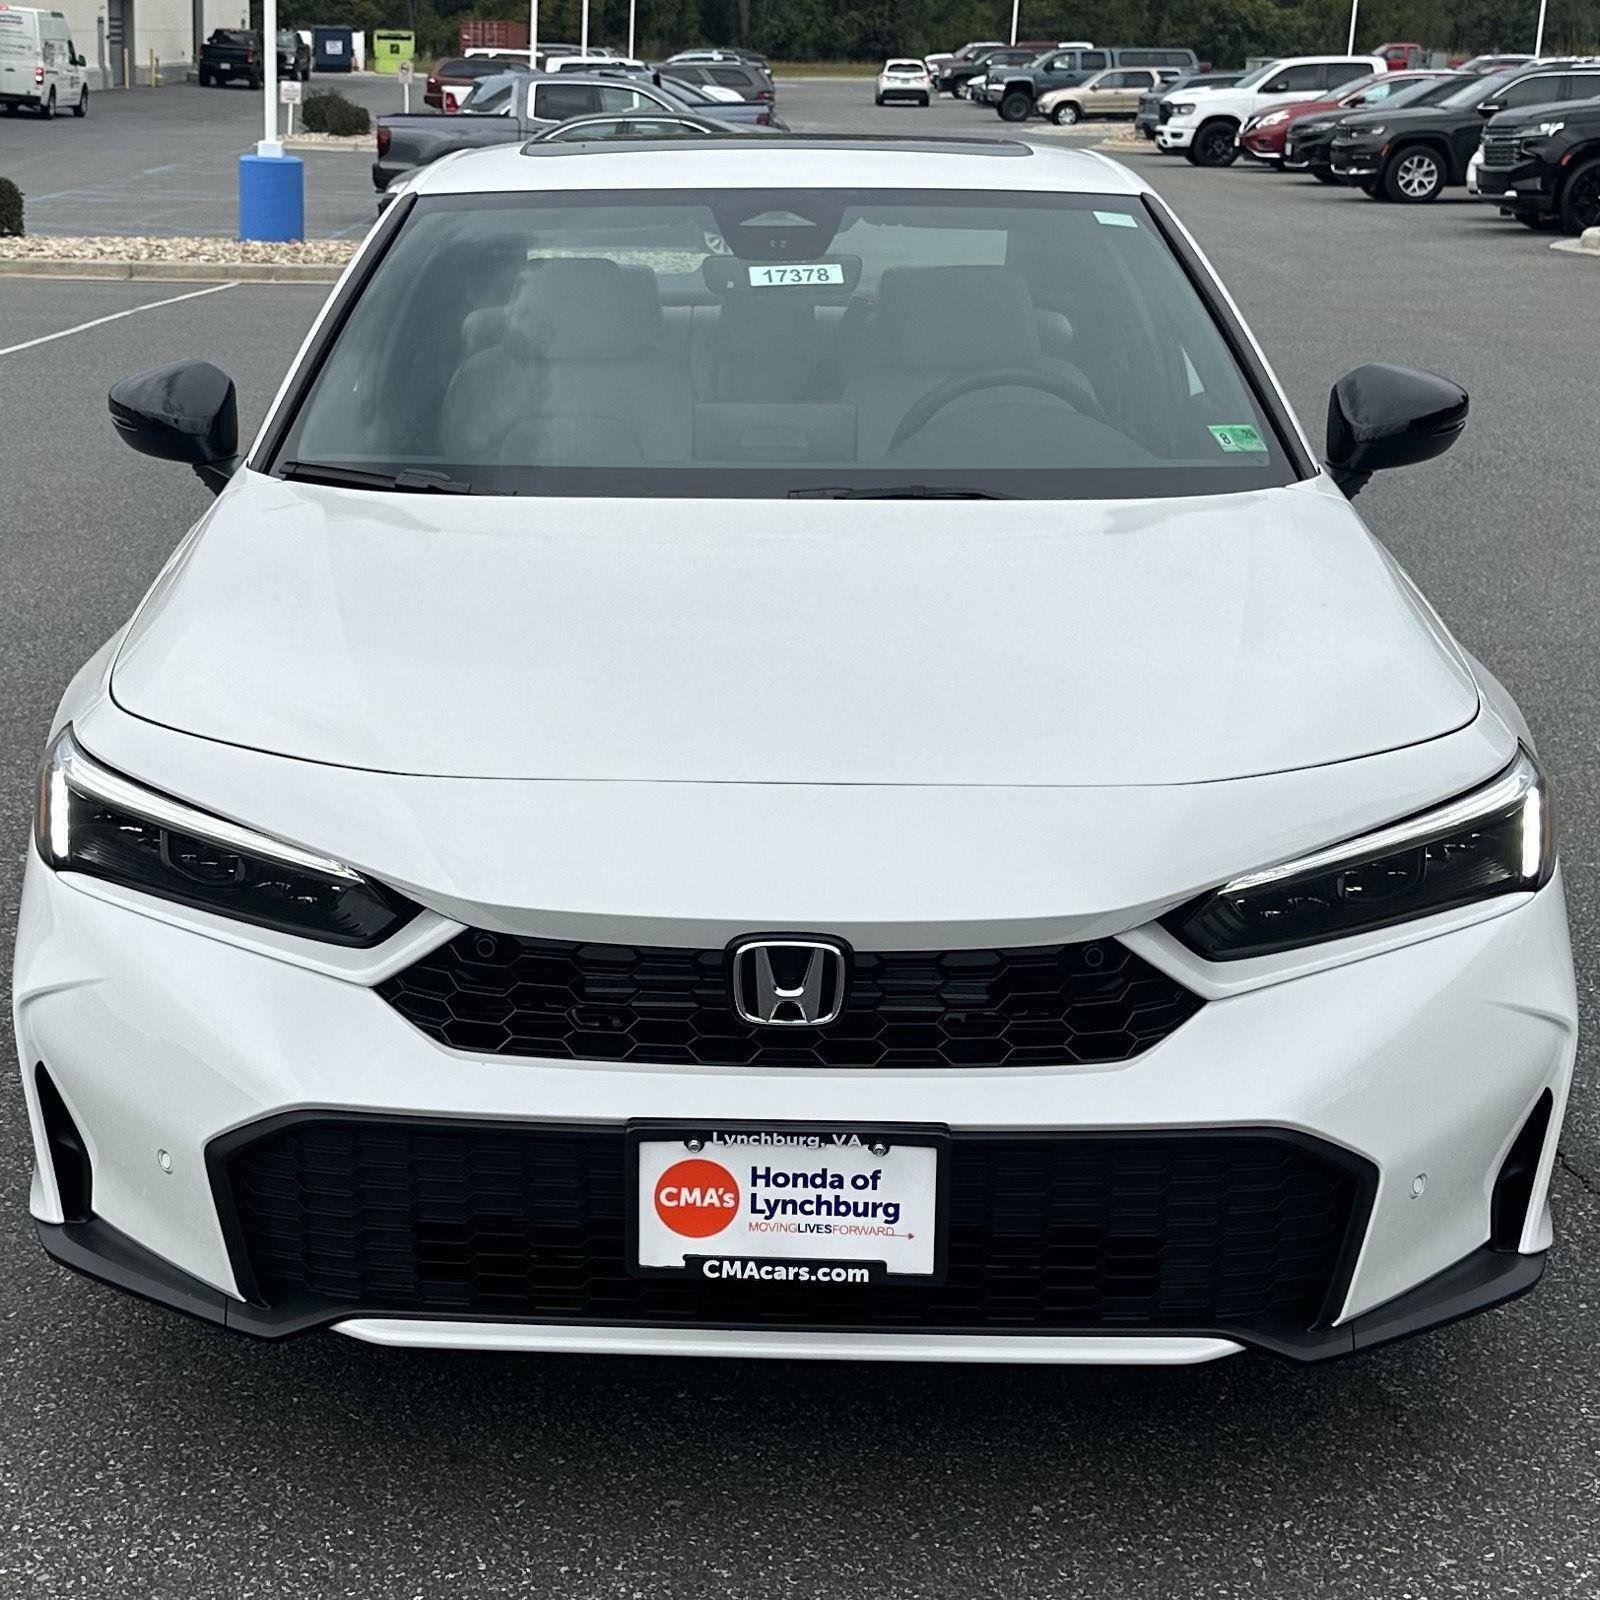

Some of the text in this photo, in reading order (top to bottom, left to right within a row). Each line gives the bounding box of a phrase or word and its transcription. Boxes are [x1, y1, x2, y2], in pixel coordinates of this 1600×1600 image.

[763, 268, 829, 283] 17378
[1220, 433, 1231, 444] 8
[712, 1131, 826, 1148] Lynchburg,
[750, 1166, 882, 1191] Honda of
[659, 1186, 736, 1208] CMA's
[750, 1192, 900, 1225] Lynchburg
[702, 1259, 870, 1283] CMAcars.com
